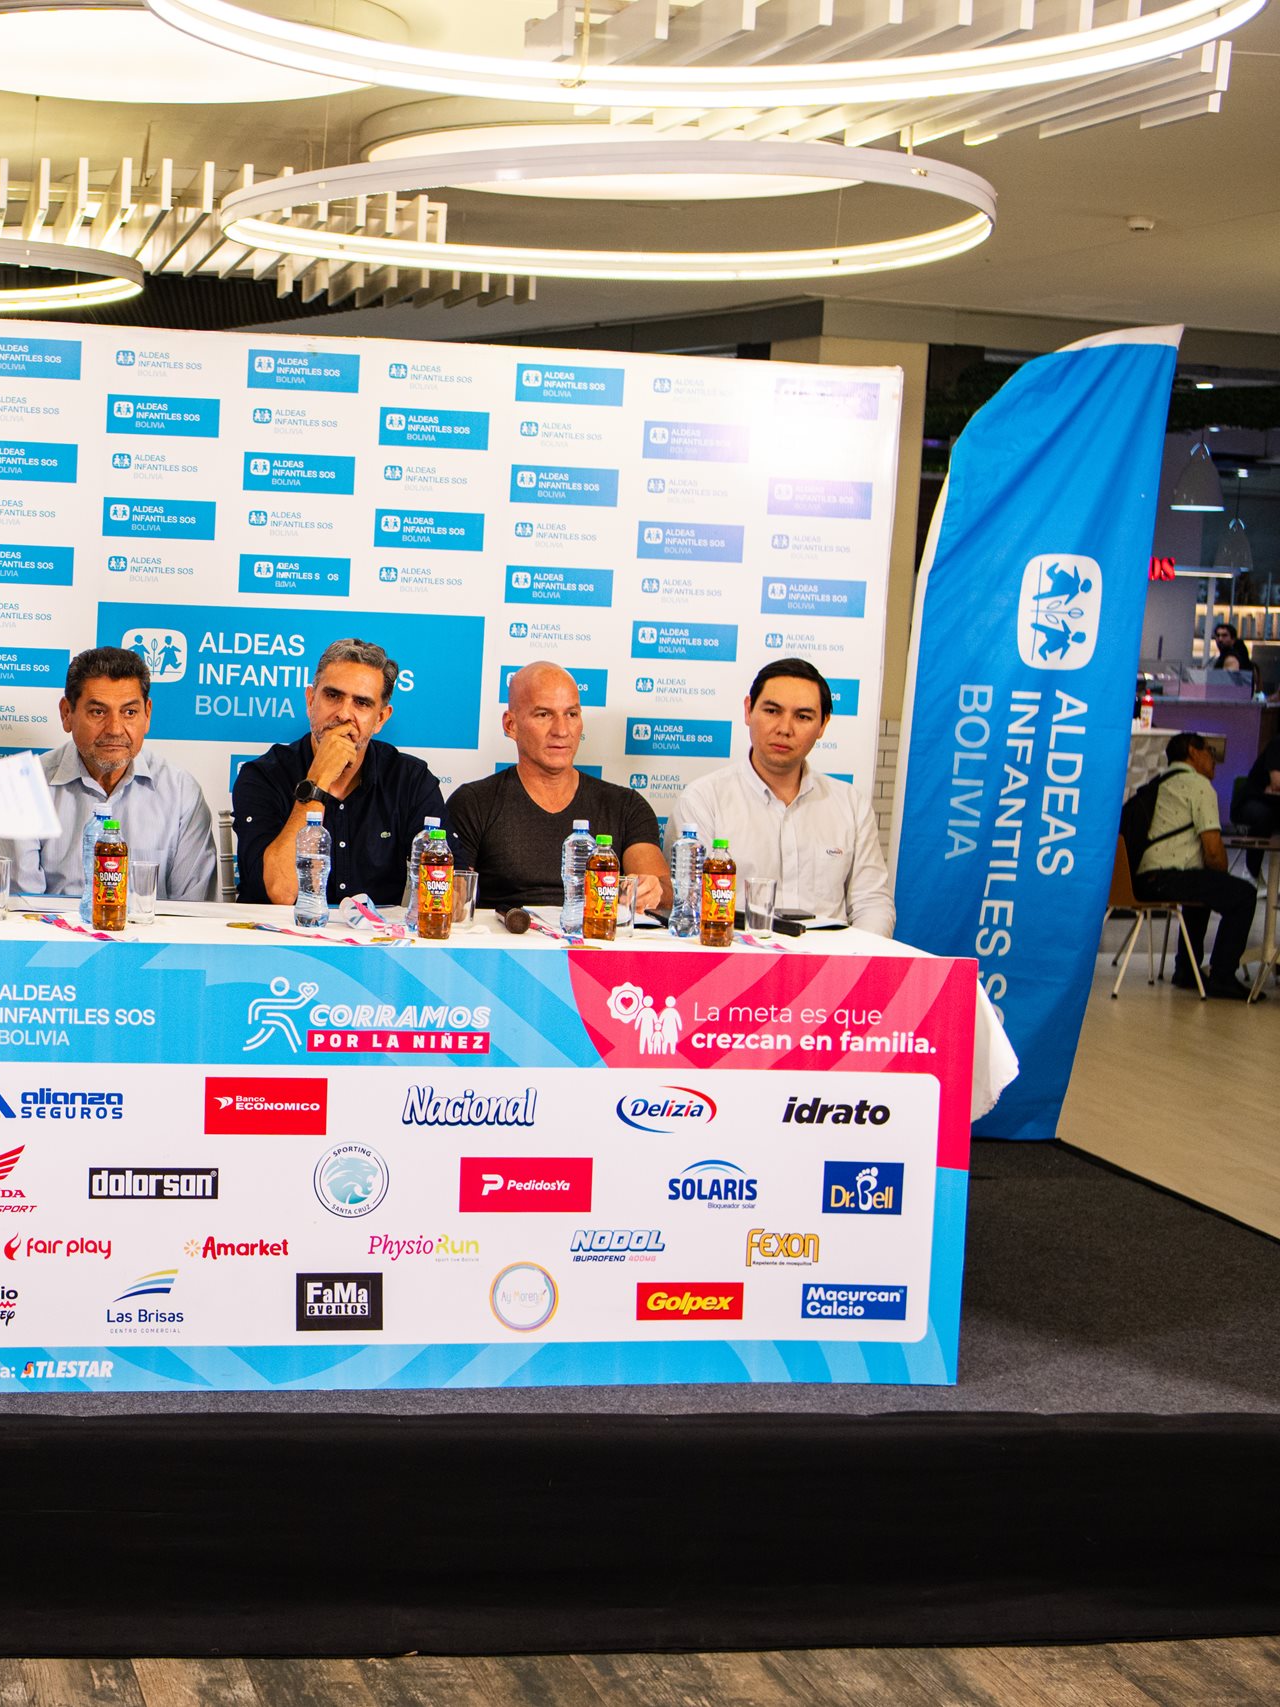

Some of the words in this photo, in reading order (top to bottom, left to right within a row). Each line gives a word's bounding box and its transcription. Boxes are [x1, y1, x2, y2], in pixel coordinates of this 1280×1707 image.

[44, 355, 62, 364] SOS
[138, 351, 170, 360] ALDEAS
[138, 361, 184, 370] INFANTILES
[186, 362, 202, 371] SOS
[277, 357, 309, 367] ALDEAS
[276, 367, 322, 376] INFANTILES
[322, 368, 341, 377] SOS
[544, 372, 575, 381] ALDEAS
[275, 376, 306, 385] BOLIVIA
[543, 381, 588, 391] INFANTILES
[589, 382, 606, 391] SOS
[542, 389, 571, 398] BOLIVIA
[136, 402, 168, 411] ALDEAS
[136, 411, 182, 421] INFANTILES
[183, 413, 201, 422] SOS
[408, 415, 439, 424] ALDEAS
[135, 421, 165, 429] BOLIVIA
[407, 425, 453, 434] INFANTILES
[453, 426, 470, 435] SOS
[406, 433, 436, 442] BOLIVIA
[403, 517, 435, 526] ALDEAS
[403, 526, 447, 535] INFANTILES
[448, 527, 465, 536] SOS
[402, 534, 431, 543] BOLIVIA
[36, 561, 54, 570] SOS
[533, 573, 564, 582] ALDEAS
[532, 582, 577, 591] INFANTILES
[577, 583, 594, 592] SOS
[531, 590, 561, 599] BOLIVIA
[659, 628, 689, 637] ALDEAS
[198, 632, 305, 657] ALDEAS
[658, 637, 702, 646] INFANTILES
[702, 638, 719, 647] SOS
[657, 645, 687, 654] BOLIVIA
[198, 663, 312, 688] INFANTIL
[194, 695, 295, 719] BOLIVIA
[654, 725, 684, 734] ALDEAS
[653, 734, 697, 743] INFANTILES
[697, 735, 713, 743] SOS
[652, 742, 680, 750] BOLIVIA
[944, 683, 993, 861] BOLIVIA
[1036, 689, 1088, 876] ALDEAS
[975, 690, 1042, 957] INFANTILES
[0, 1007, 110, 1025] INFANTILES
[114, 1009, 156, 1026] SOS
[309, 1004, 491, 1029] CORRAMOS
[694, 1002, 721, 1022] La
[728, 1004, 792, 1024] meta
[800, 1009, 827, 1025] es
[834, 1009, 882, 1032] que
[313, 1033, 359, 1048] POR
[371, 1034, 399, 1048] LA
[412, 1032, 484, 1049] NIÑEZ
[691, 1032, 792, 1050] crezcan
[800, 1034, 832, 1051] en
[840, 1031, 937, 1054] familia.
[21, 1088, 123, 1105] alianza
[235, 1095, 266, 1103] Banco
[235, 1102, 320, 1111] ECONOMICO
[402, 1085, 537, 1127] Nacional
[630, 1098, 705, 1118] Delizia
[782, 1097, 891, 1125] idrato
[21, 1106, 123, 1119] SEGUROS
[332, 1146, 372, 1158] SPORTING
[507, 1179, 570, 1192] PedidosYa
[668, 1178, 757, 1201] SOLARIS
[831, 1185, 856, 1208] Dr.
[331, 1204, 353, 1215] SANTA
[354, 1204, 372, 1215] CRUZ
[570, 1230, 666, 1252] NODOL
[27, 1237, 63, 1257] fair
[66, 1237, 112, 1260] play
[202, 1235, 289, 1260] Amarket
[306, 1282, 368, 1303] FaMa
[646, 1291, 735, 1315] Golpex
[806, 1301, 865, 1316] Calcio
[308, 1304, 367, 1315] eventos
[106, 1309, 133, 1323] Las
[138, 1308, 184, 1323] Brisas
[20, 1360, 114, 1379] ATLESTAR
